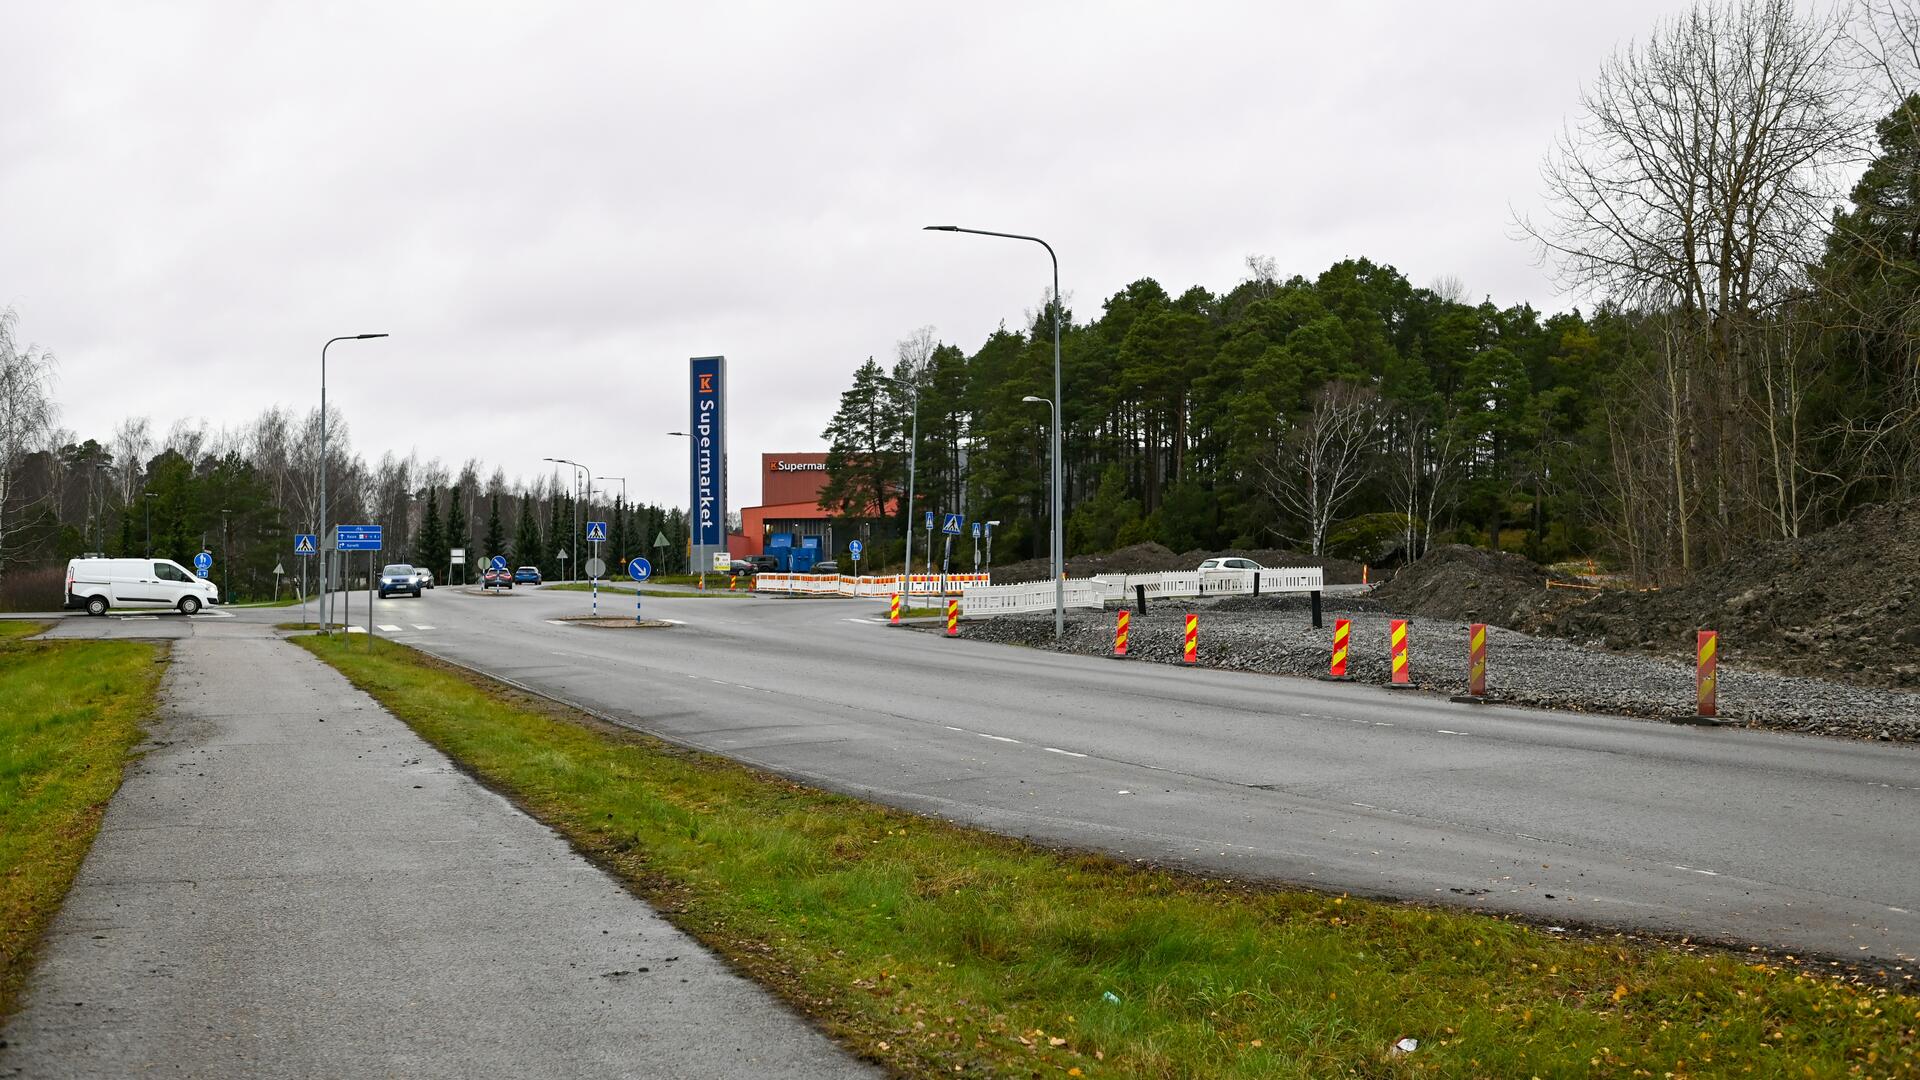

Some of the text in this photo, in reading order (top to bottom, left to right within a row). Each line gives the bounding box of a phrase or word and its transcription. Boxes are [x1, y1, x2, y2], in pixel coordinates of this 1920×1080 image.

[698, 376, 714, 528] K Supermarket
[778, 461, 842, 472] Supermar
